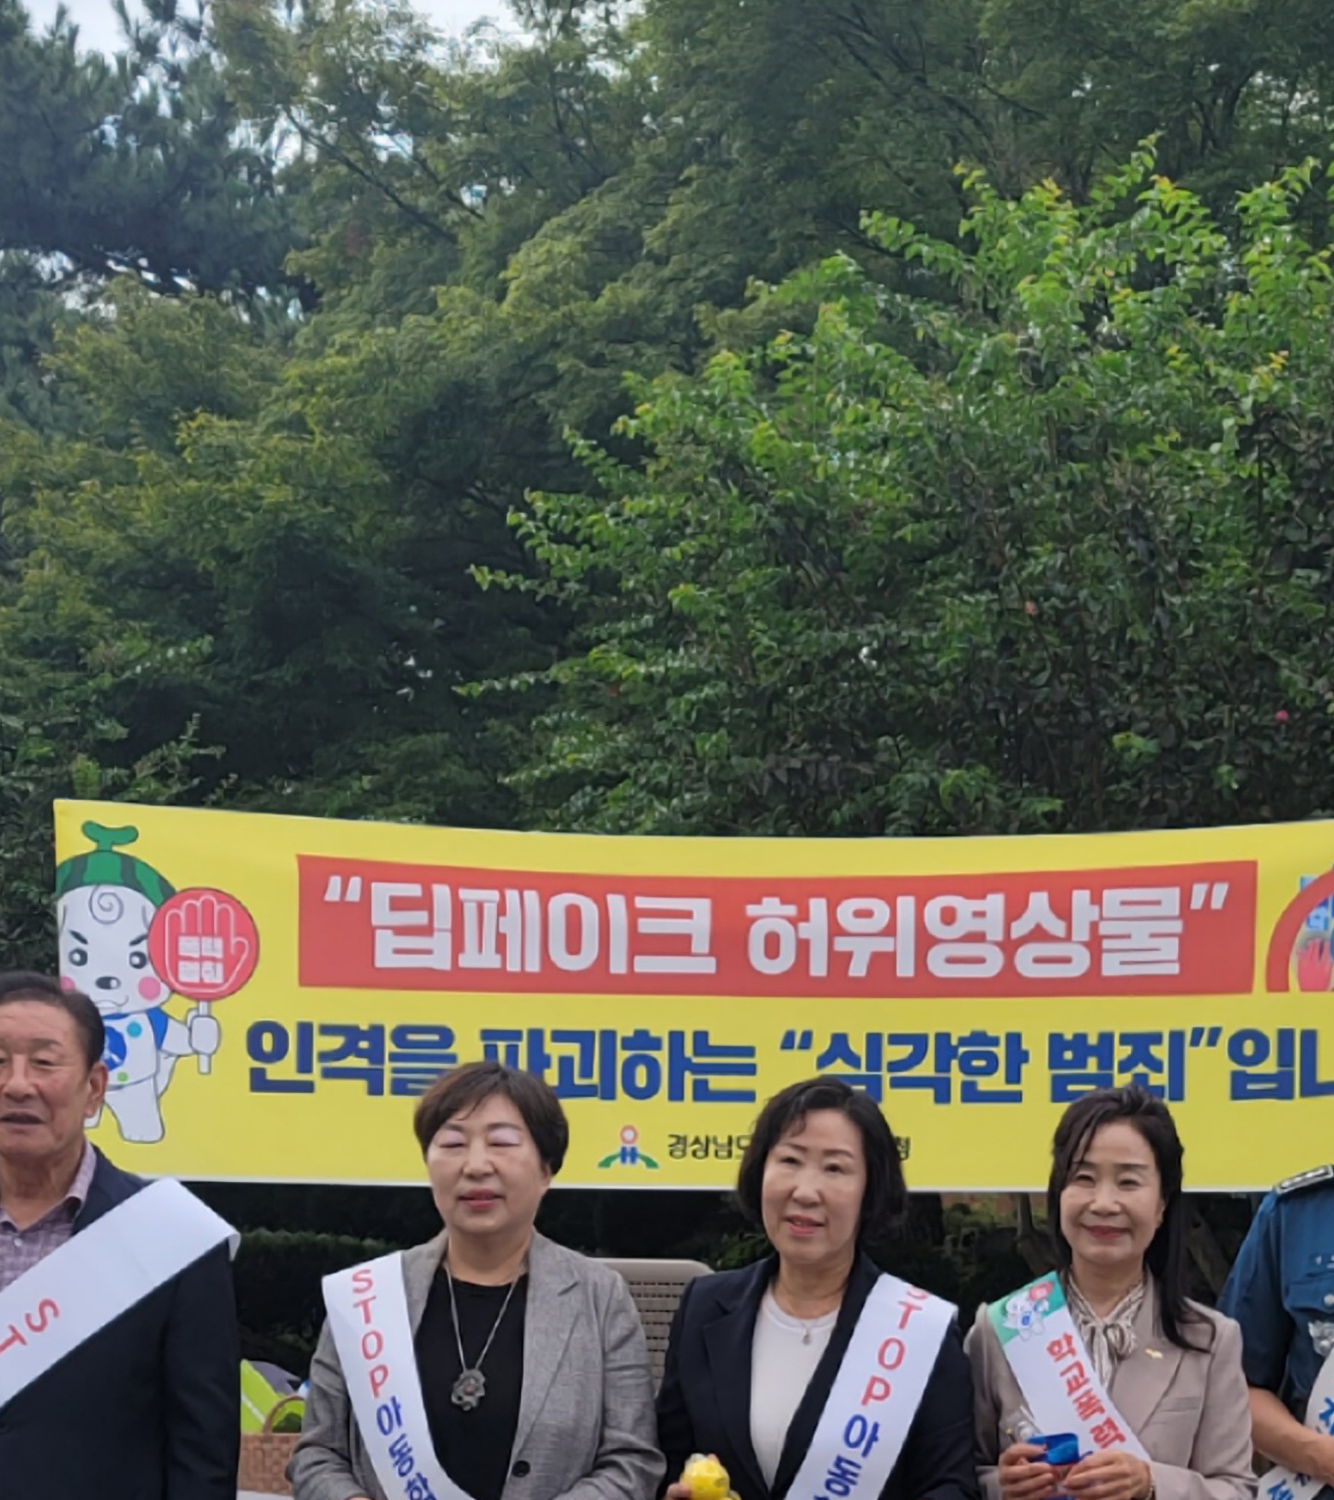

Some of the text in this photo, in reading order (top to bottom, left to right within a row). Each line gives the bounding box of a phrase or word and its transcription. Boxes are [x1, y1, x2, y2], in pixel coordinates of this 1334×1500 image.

[246, 1020, 457, 1096] 인격을
[480, 1028, 757, 1104] 파괴하는
[351, 1268, 390, 1399] STOP
[1046, 1332, 1127, 1450] 학교폭력
